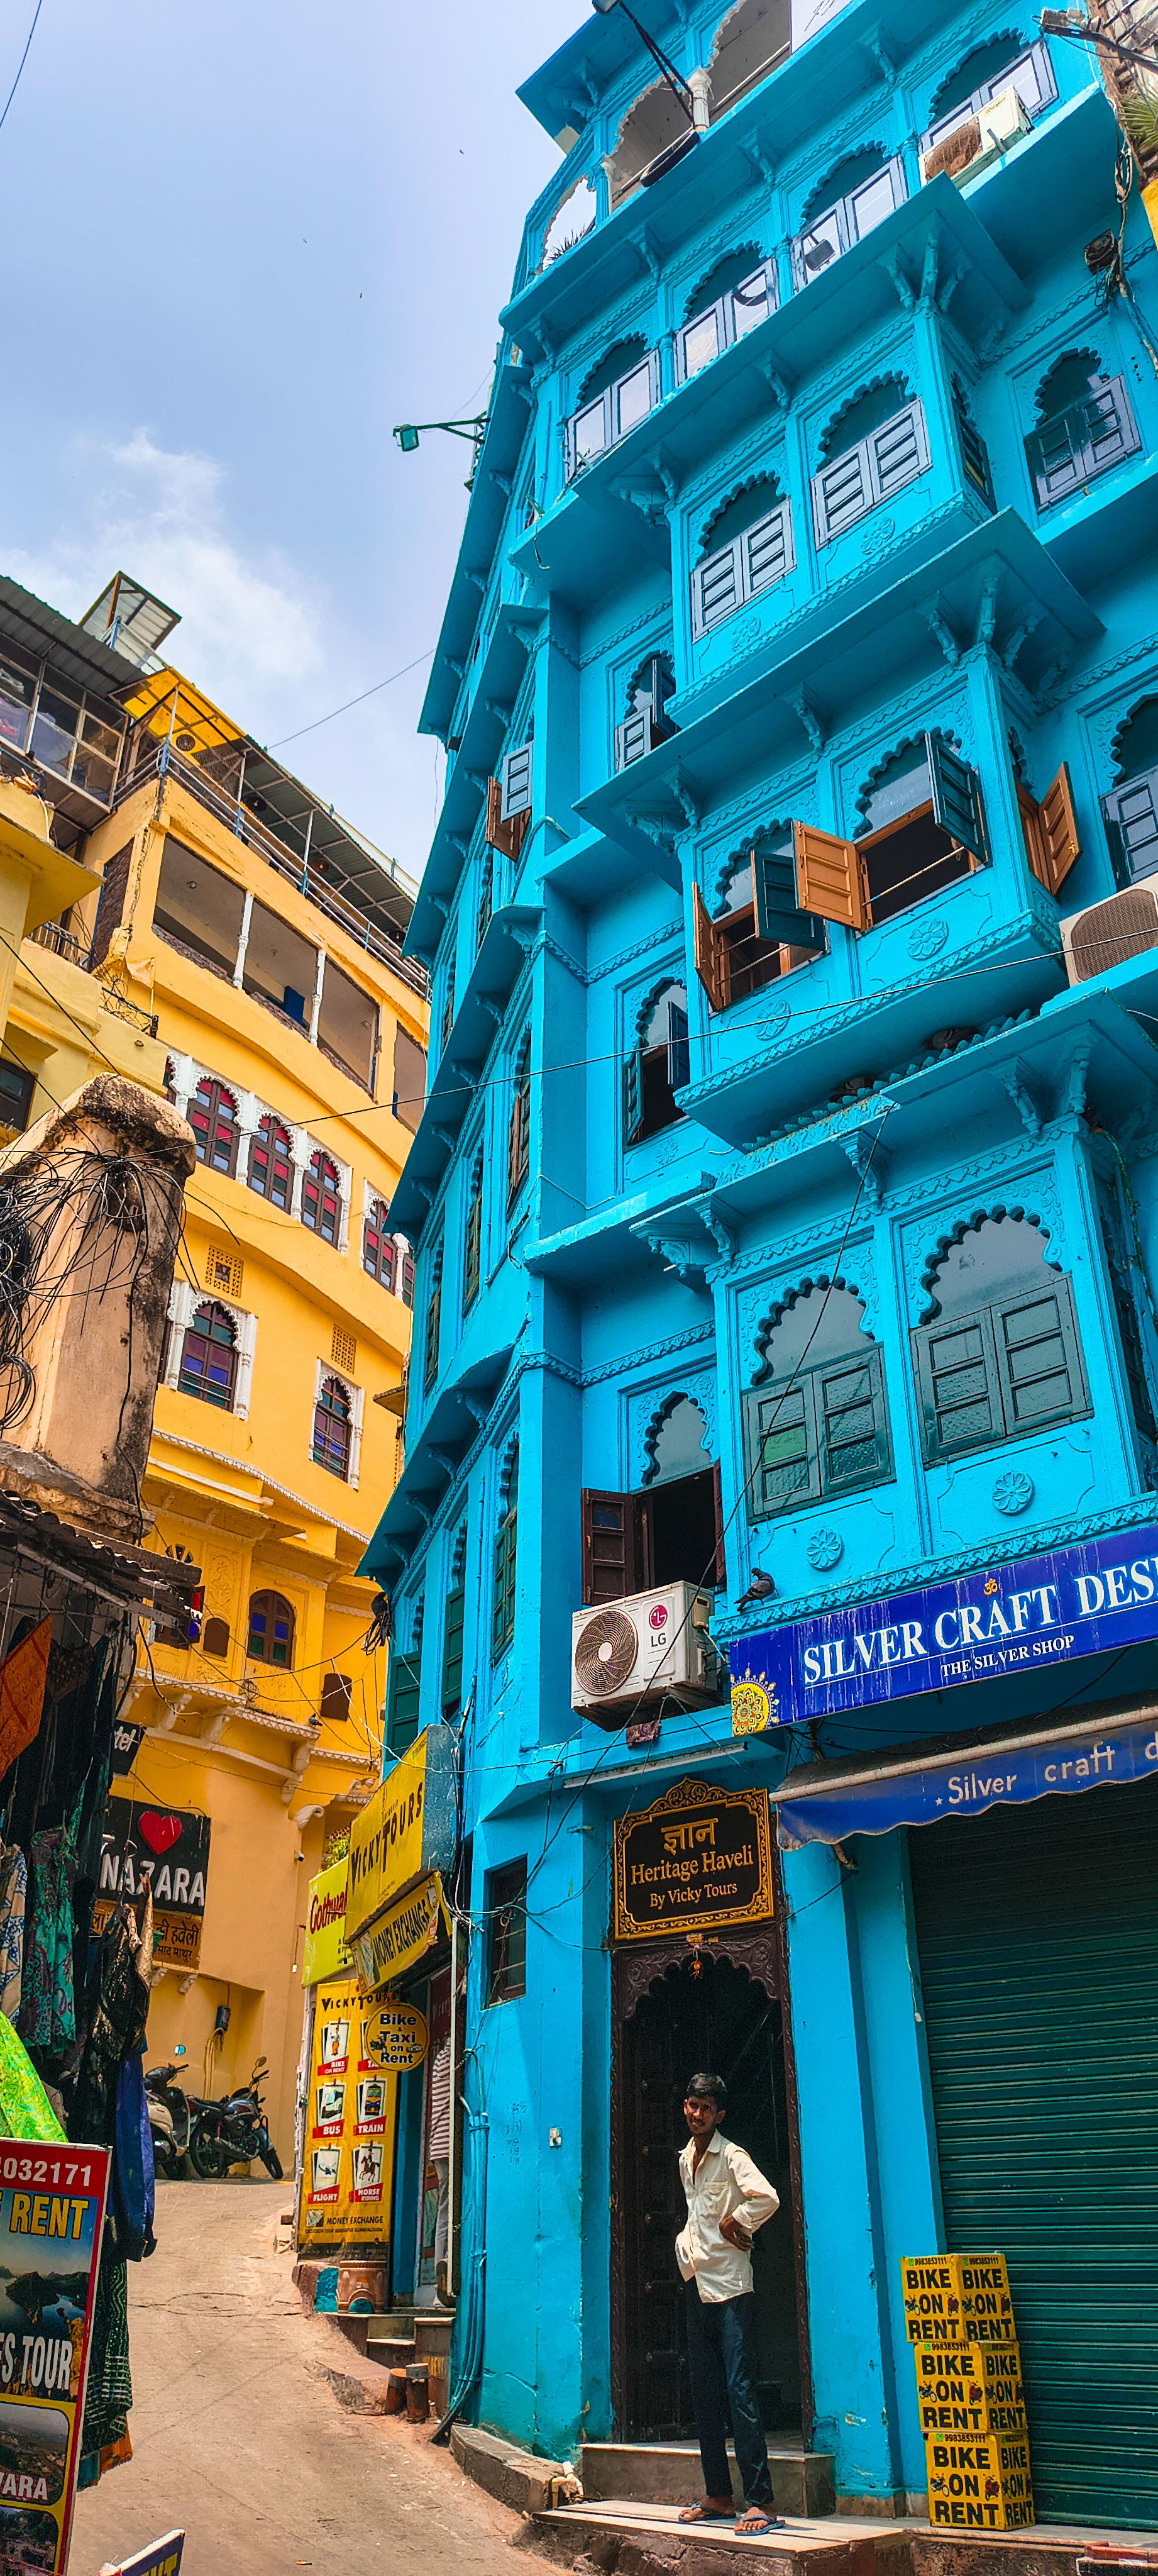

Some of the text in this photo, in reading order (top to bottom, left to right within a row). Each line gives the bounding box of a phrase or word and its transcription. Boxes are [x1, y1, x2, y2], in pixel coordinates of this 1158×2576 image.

[651, 1633, 666, 1647] LG
[804, 1621, 927, 1684] SILVER
[935, 1585, 1056, 1649] CRAFT
[942, 1635, 1074, 1677] THE SILVER SHOP
[948, 1773, 1017, 1804] Silver
[1045, 1741, 1115, 1782] craft
[661, 1818, 719, 1855] ज्ञान
[631, 1845, 754, 1885] Heritage Haveli
[100, 1853, 204, 1907] NAZARA
[649, 1884, 737, 1910] By Vicky Tours
[170, 1920, 199, 1947] हवेली
[373, 1924, 397, 1968] MONEY
[392, 1899, 430, 1954] EXCHANGE
[380, 2013, 417, 2025] Bike
[380, 2031, 416, 2043] Taxi
[380, 2053, 414, 2063] Rent
[323, 2126, 341, 2135] BUS
[358, 2124, 383, 2133] TRAIN
[0, 2157, 91, 2187] 032171
[9, 2192, 89, 2240] RENT
[906, 2268, 952, 2289] BIKE
[962, 2268, 1004, 2289] BIKE
[919, 2294, 944, 2314] ON
[974, 2294, 998, 2314] ON
[908, 2319, 959, 2340] RENT
[966, 2318, 1012, 2341] RENT
[21, 2335, 73, 2390] TOUR
[921, 2355, 975, 2376] BIKE
[986, 2355, 1018, 2376] BIKE
[935, 2380, 964, 2402] ON
[996, 2380, 1013, 2402] ON
[923, 2407, 983, 2429] RENT
[989, 2407, 1024, 2429] RENT
[933, 2446, 991, 2469] BIKE
[1001, 2446, 1027, 2469] BIKE
[949, 2473, 979, 2497] ON
[1010, 2473, 1024, 2497] ON
[934, 2501, 999, 2526] RENT
[1005, 2501, 1033, 2526] RENT
